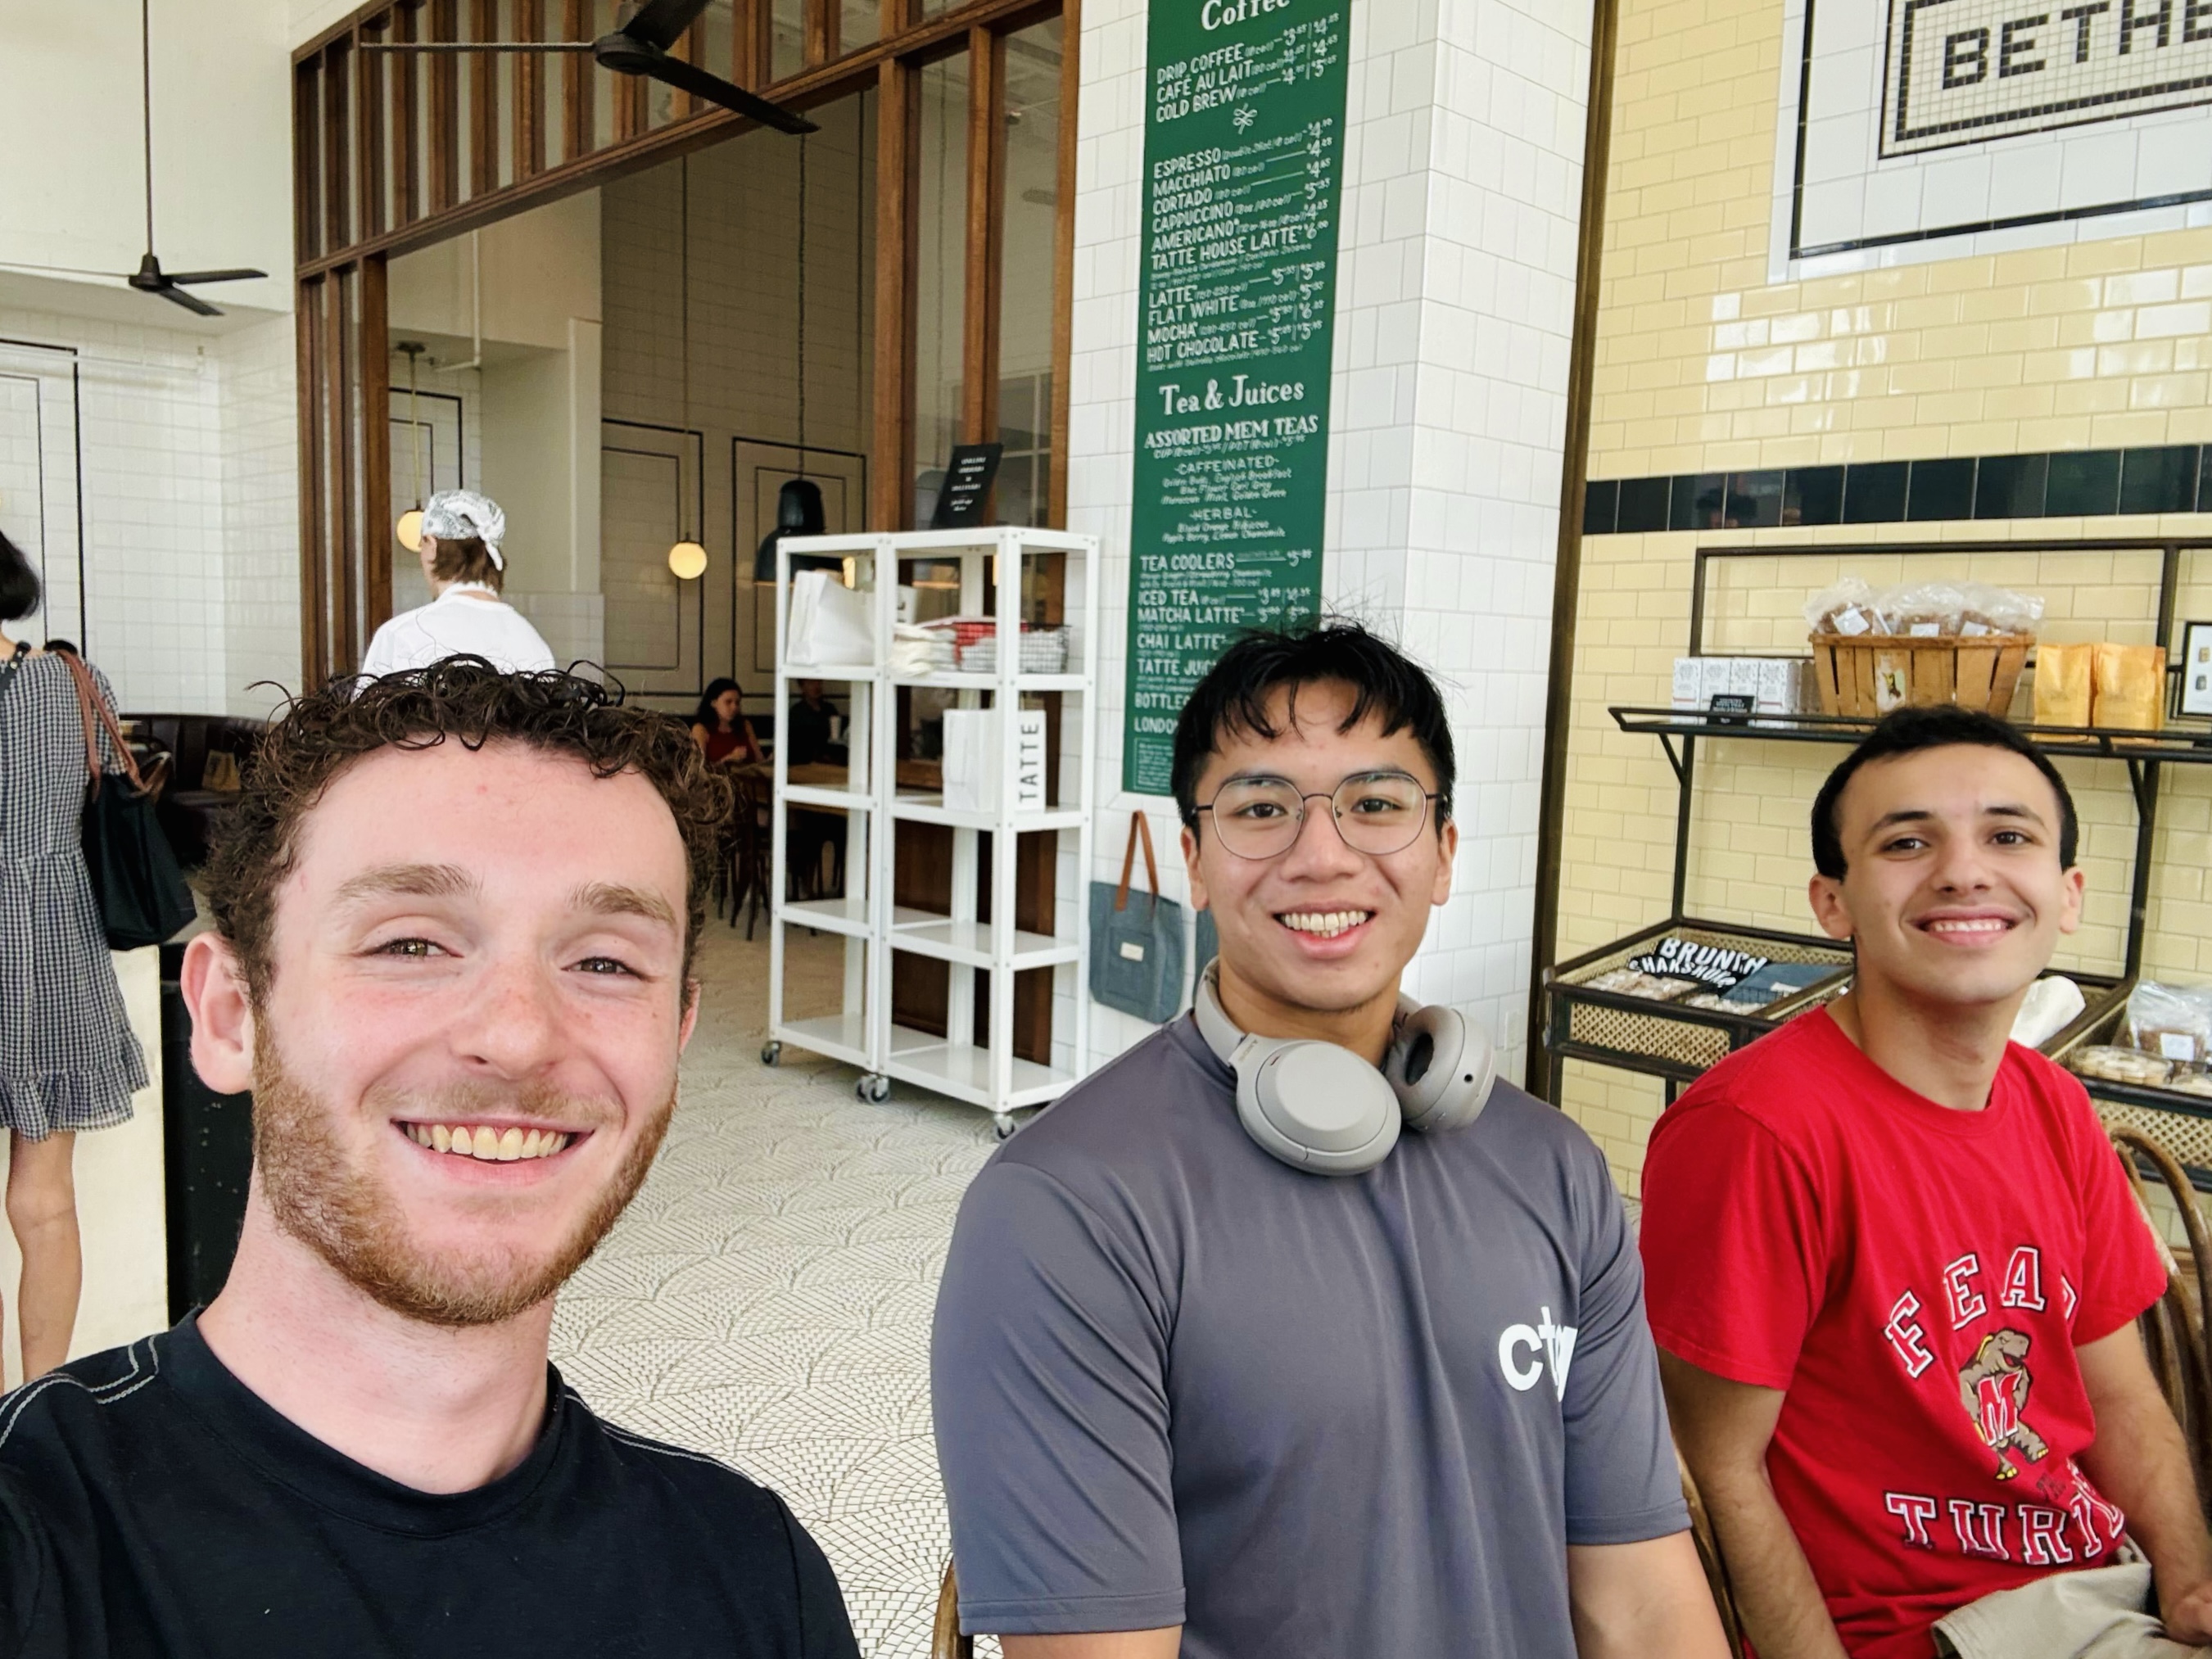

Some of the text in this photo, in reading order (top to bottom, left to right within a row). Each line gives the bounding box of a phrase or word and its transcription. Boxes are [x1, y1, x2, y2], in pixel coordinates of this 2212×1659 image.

[1156, 61, 1187, 84] DRIP
[1190, 43, 1244, 74] COFFEE
[1195, 71, 1215, 93] AU
[1219, 59, 1254, 85] LAIT
[1156, 99, 1190, 123] COLD
[1192, 84, 1237, 113] BREW
[1153, 147, 1221, 179] ESPRESSO
[1152, 163, 1231, 198] MACCHIATO
[1151, 201, 1234, 233] CAPPUCCINO
[1152, 188, 1213, 215] CORTADO
[1151, 246, 1196, 271] TATTE
[1200, 236, 1246, 261] HOUSE
[1148, 304, 1186, 327] FLAT
[1190, 294, 1240, 319] WHITE
[1147, 343, 1173, 363] HOT
[1177, 330, 1260, 359] CHOCOLATE
[1159, 374, 1305, 415] Tea & Juices
[1143, 414, 1319, 449] ASSORTED MEM TEAS
[1139, 554, 1168, 572] TEA
[1170, 552, 1235, 570] COOLERS
[1138, 589, 1167, 605] ICED
[1170, 588, 1200, 605] TEA
[1138, 607, 1192, 623] MATCHA
[1137, 633, 1169, 649] CHAI
[1136, 658, 1218, 676] TATTE JUIC
[1018, 724, 1039, 803] TATTE
[1977, 1370, 2023, 1447] M
